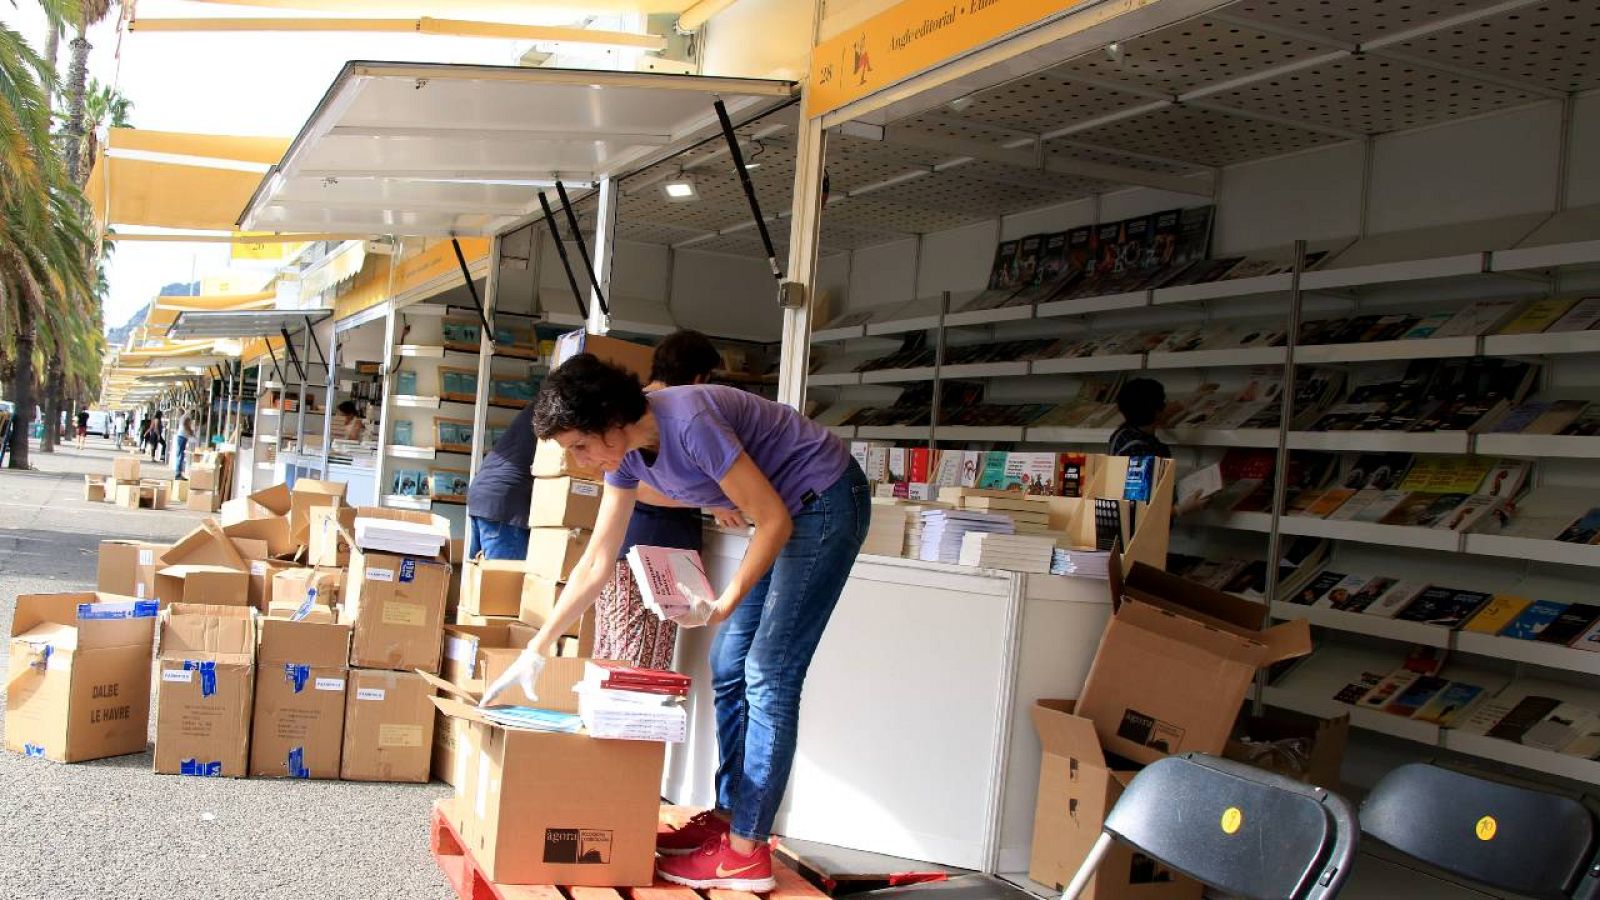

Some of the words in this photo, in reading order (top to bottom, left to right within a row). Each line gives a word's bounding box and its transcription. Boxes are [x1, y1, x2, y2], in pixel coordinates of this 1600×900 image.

[914, 6, 957, 39] editorial
[92, 683, 119, 699] DALBE
[90, 709, 101, 724] LE
[103, 705, 130, 721] HAVRE
